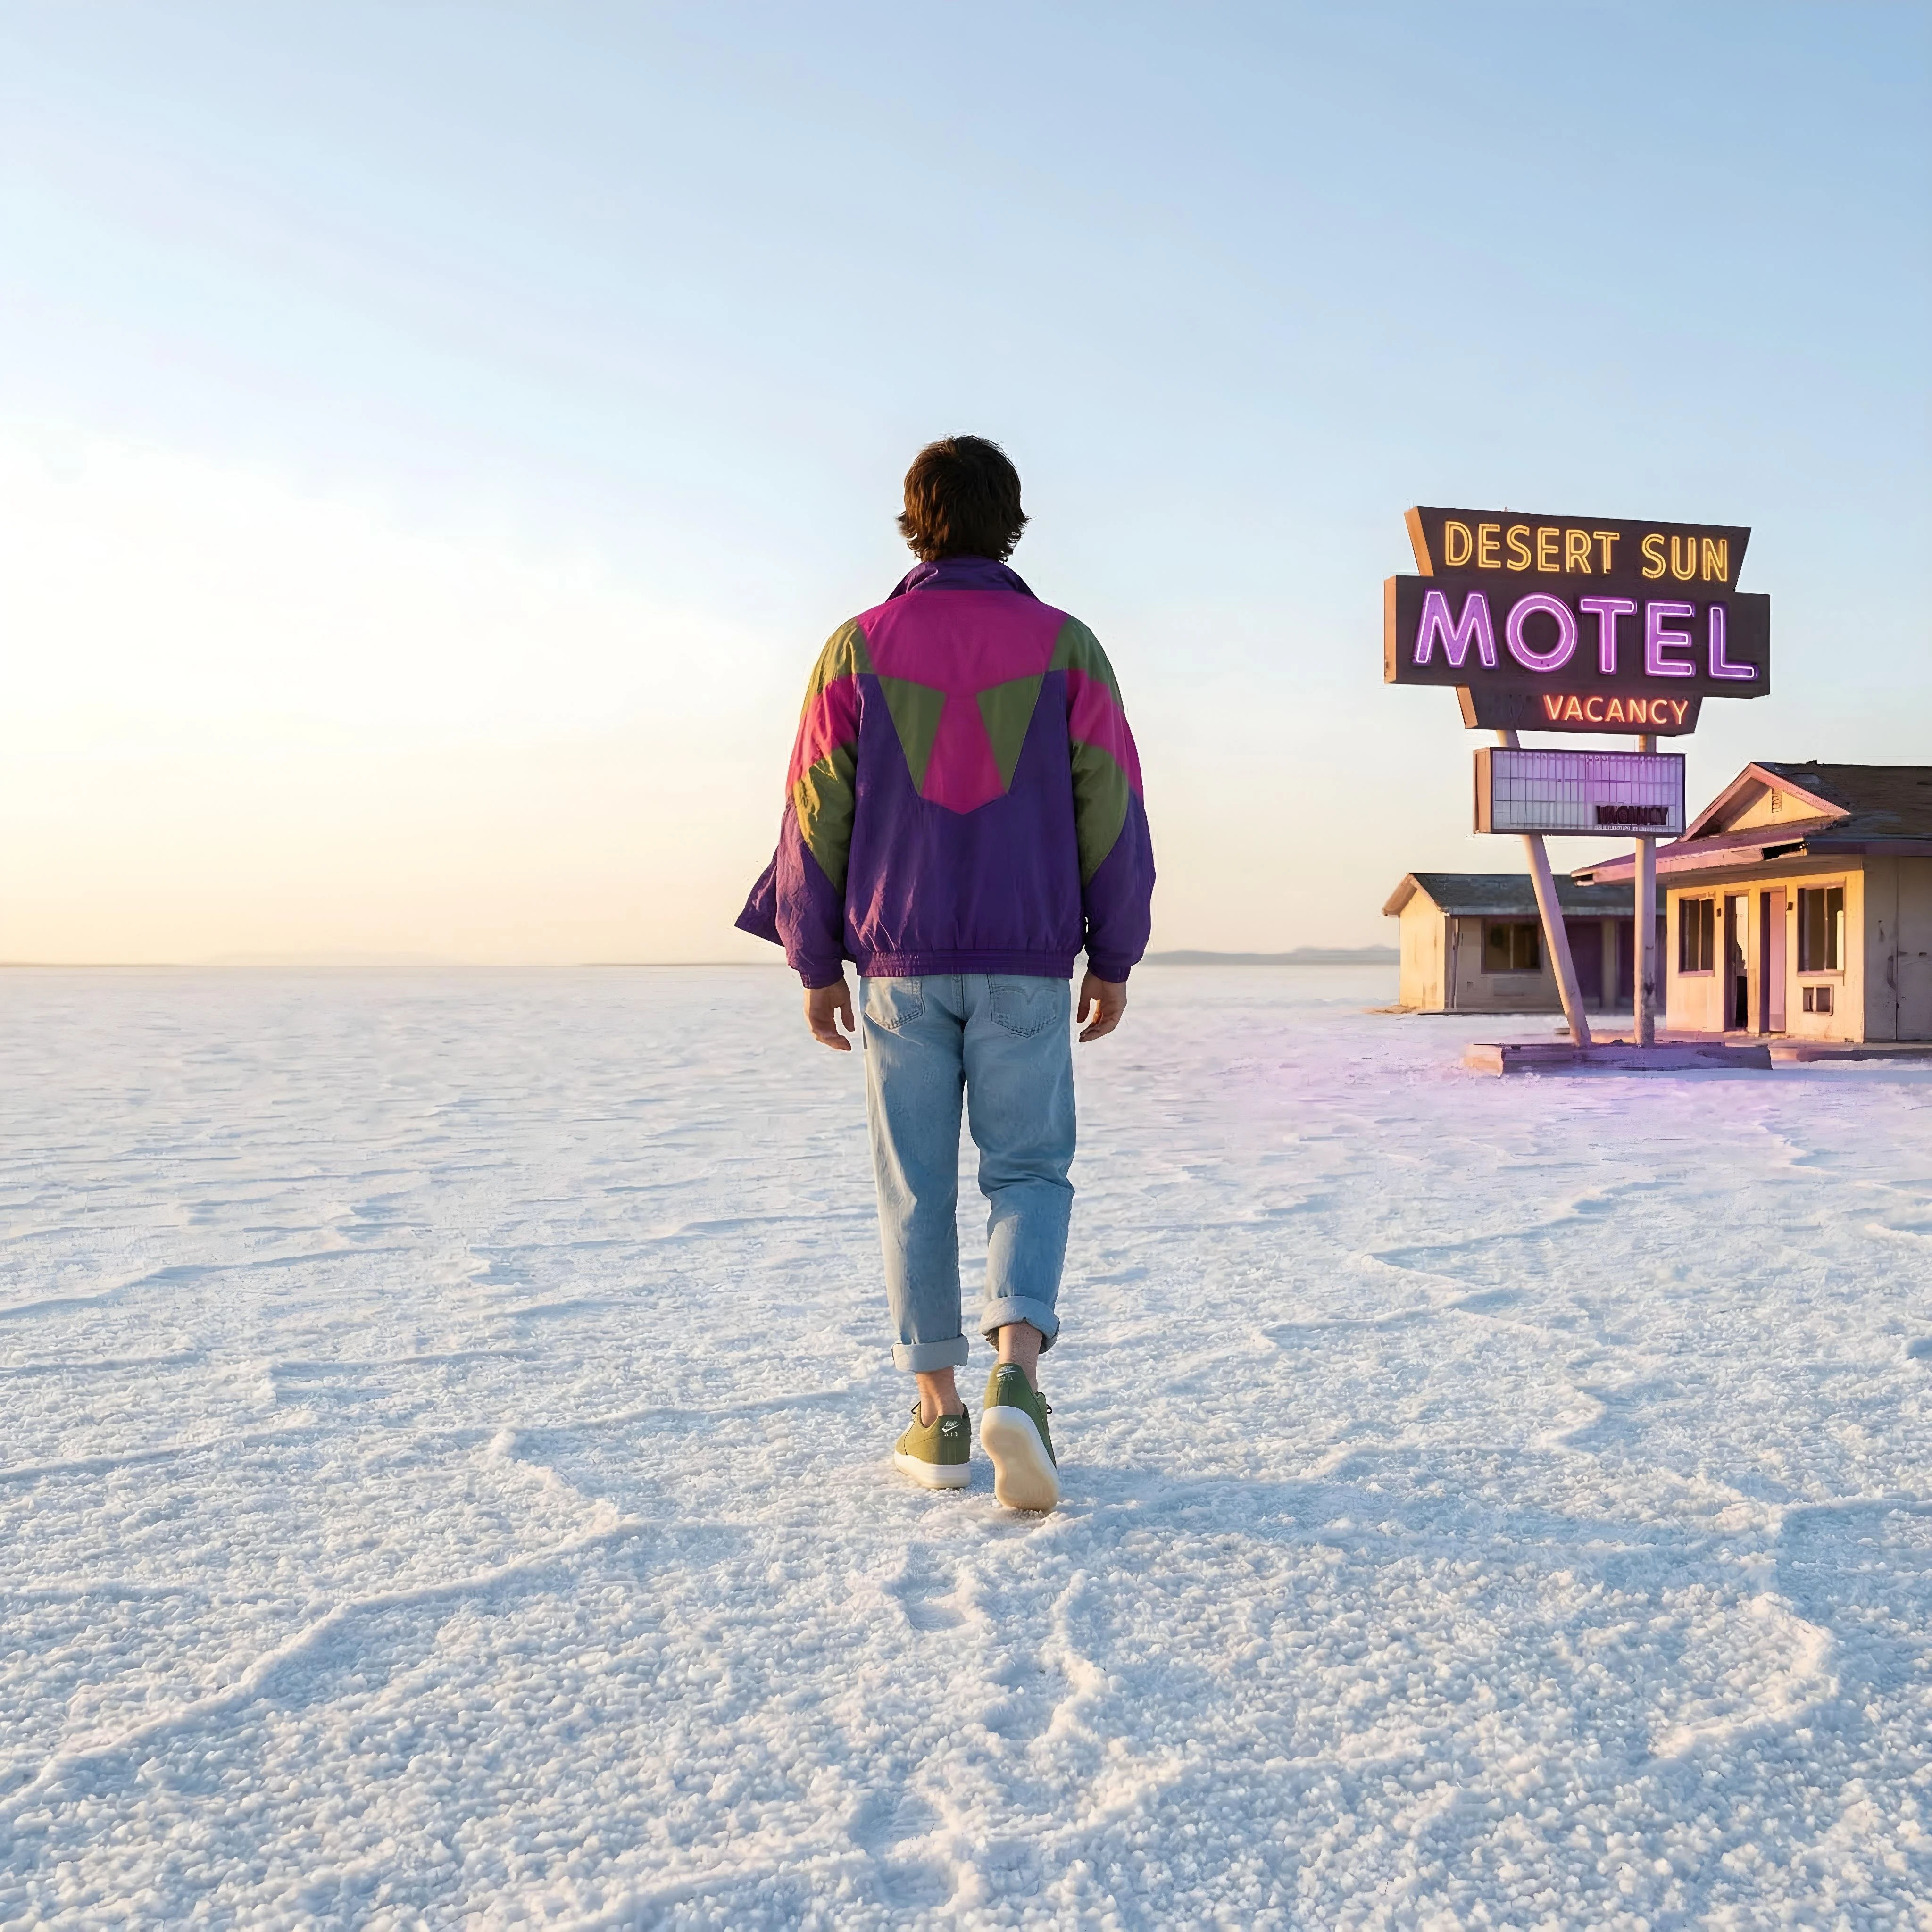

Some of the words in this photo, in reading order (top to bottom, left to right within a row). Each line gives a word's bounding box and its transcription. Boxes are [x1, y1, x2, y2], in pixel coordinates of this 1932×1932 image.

[1445, 521, 1620, 574] DESERT
[1641, 533, 1728, 582] SUN
[1413, 588, 1759, 680] MOTEL
[1543, 694, 1689, 725] VACANCY
